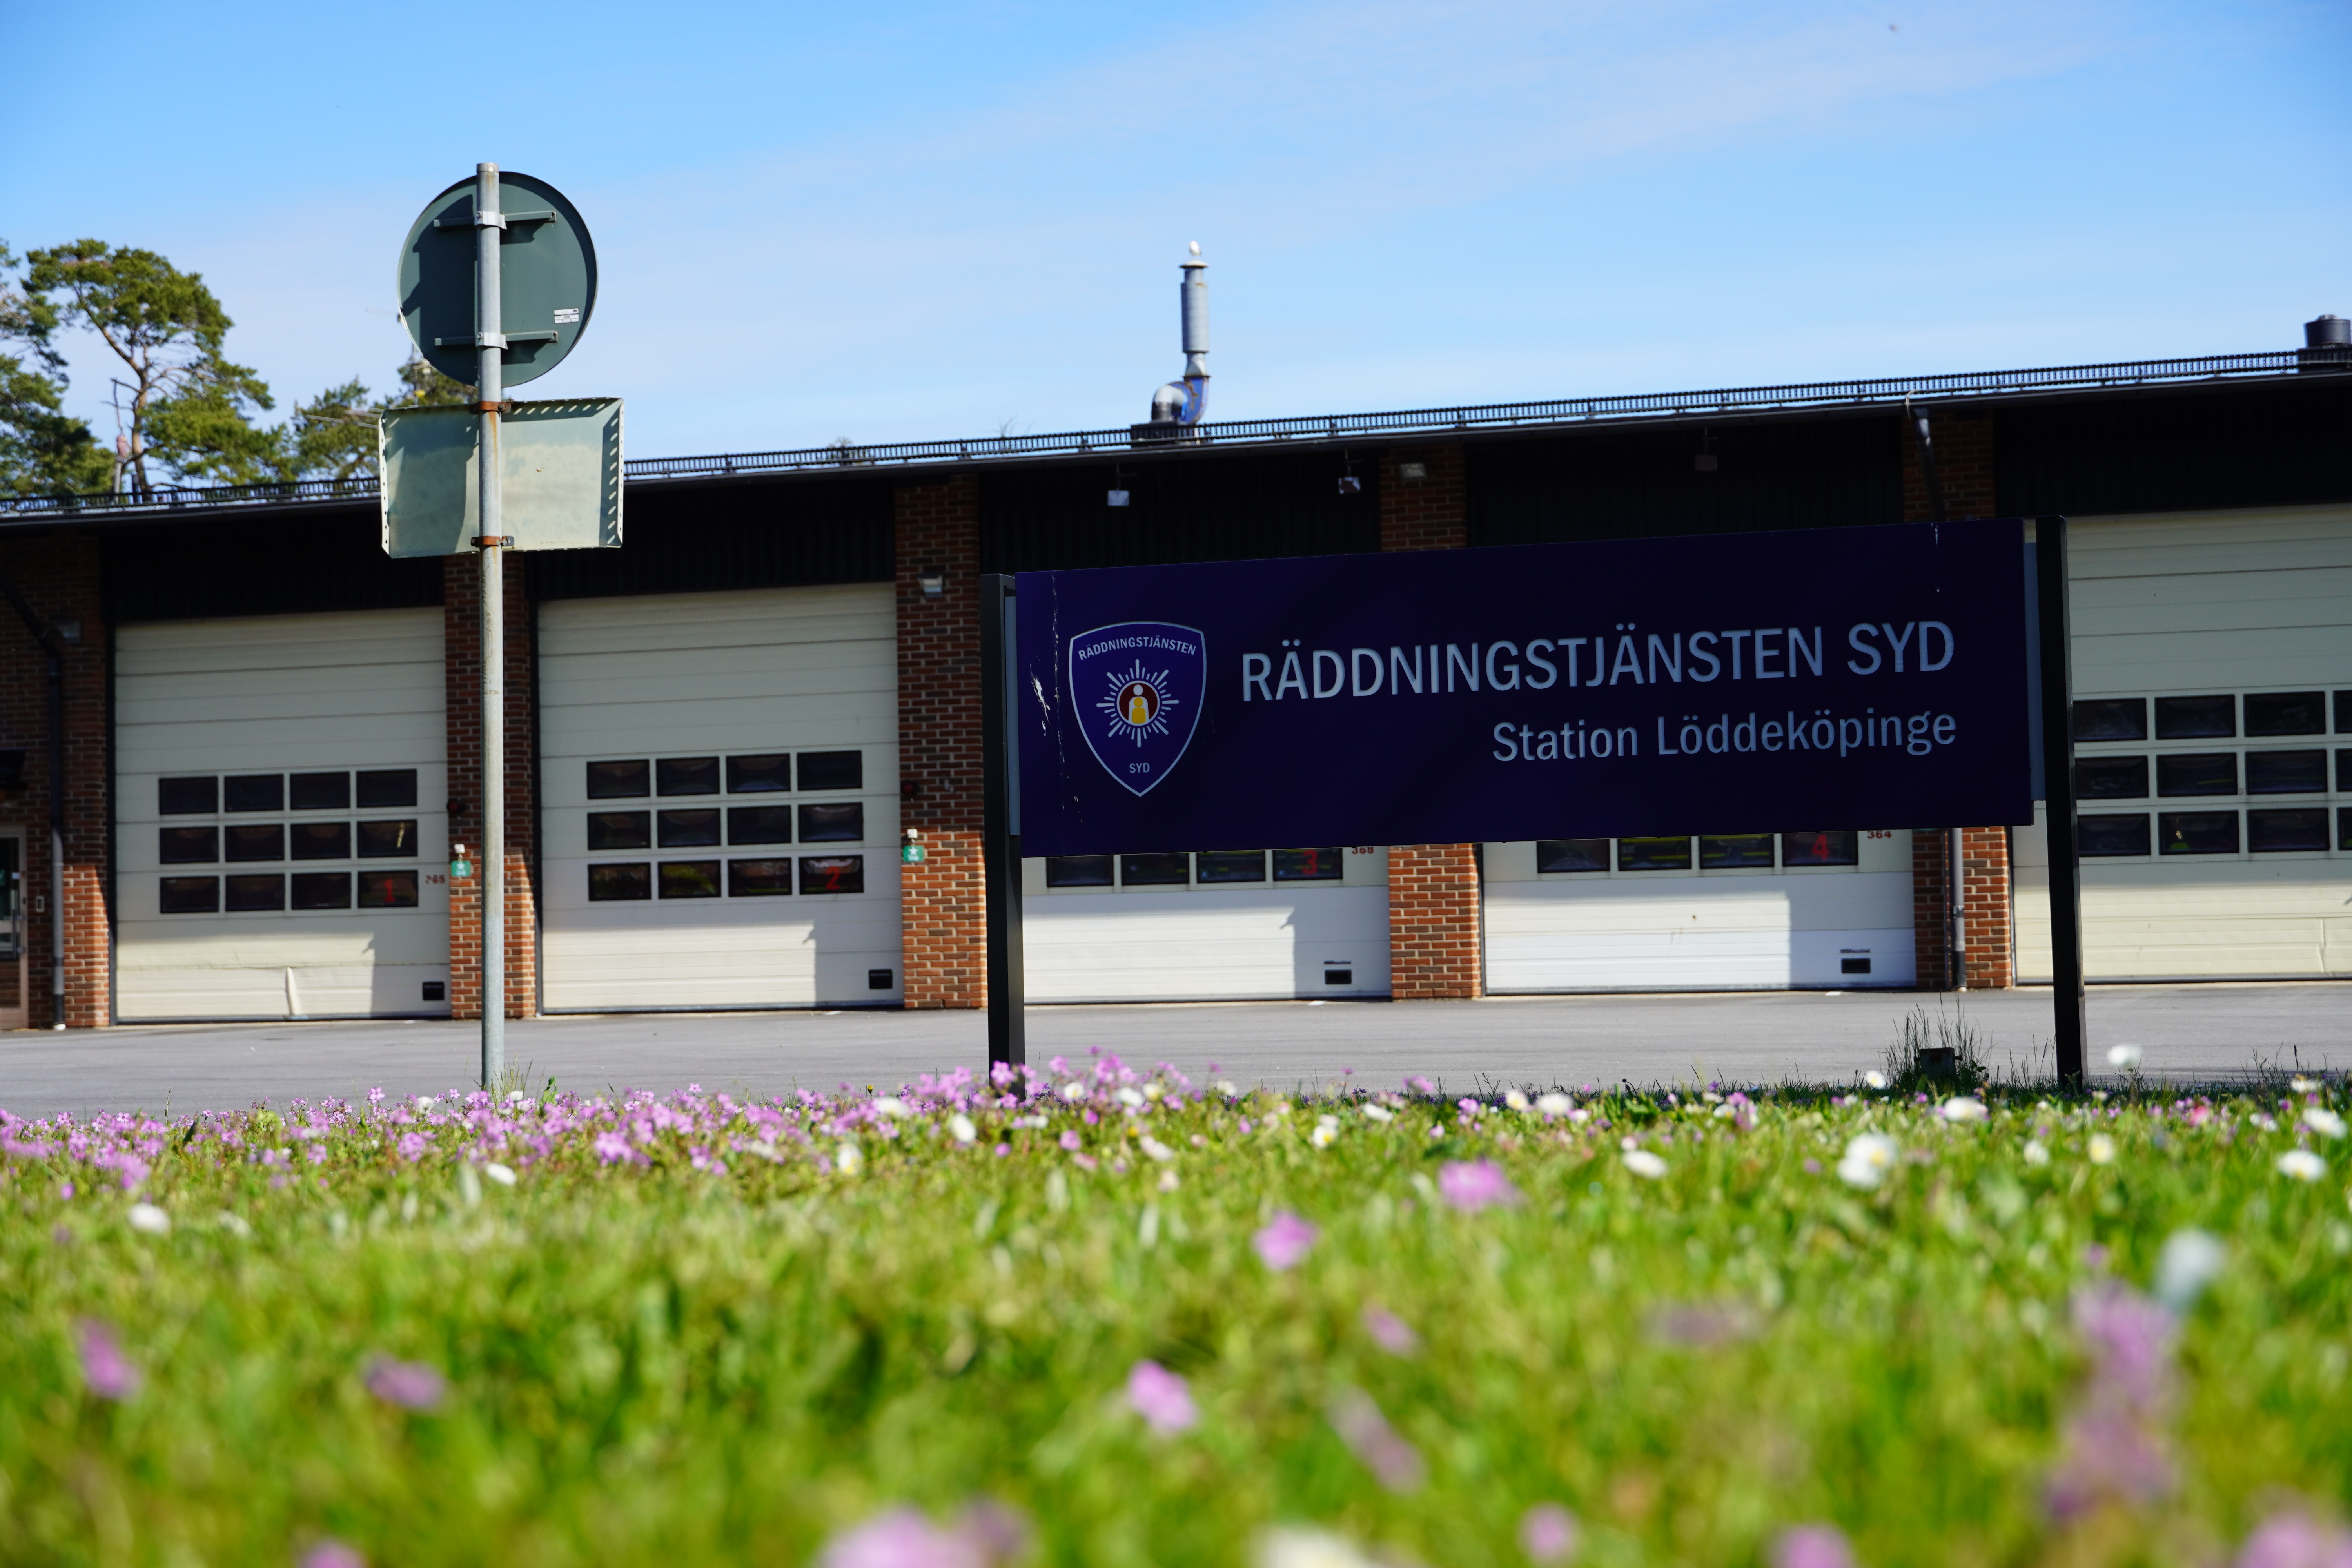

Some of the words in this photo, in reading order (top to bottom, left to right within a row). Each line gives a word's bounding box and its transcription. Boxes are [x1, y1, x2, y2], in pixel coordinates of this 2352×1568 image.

[1078, 635, 1196, 661] RÄDDNINGSTJÄNSTEN
[1243, 623, 1822, 701] RÄDDNINGSTJÄNSTEN
[1848, 622, 1953, 675] SYD
[1493, 720, 1637, 761] Station
[1658, 710, 1955, 757] Löddeköpinge
[1129, 762, 1150, 773] SYD
[1812, 834, 1829, 859] 4
[1303, 849, 1318, 875] 3
[383, 879, 396, 902] 1
[825, 866, 841, 890] 2
